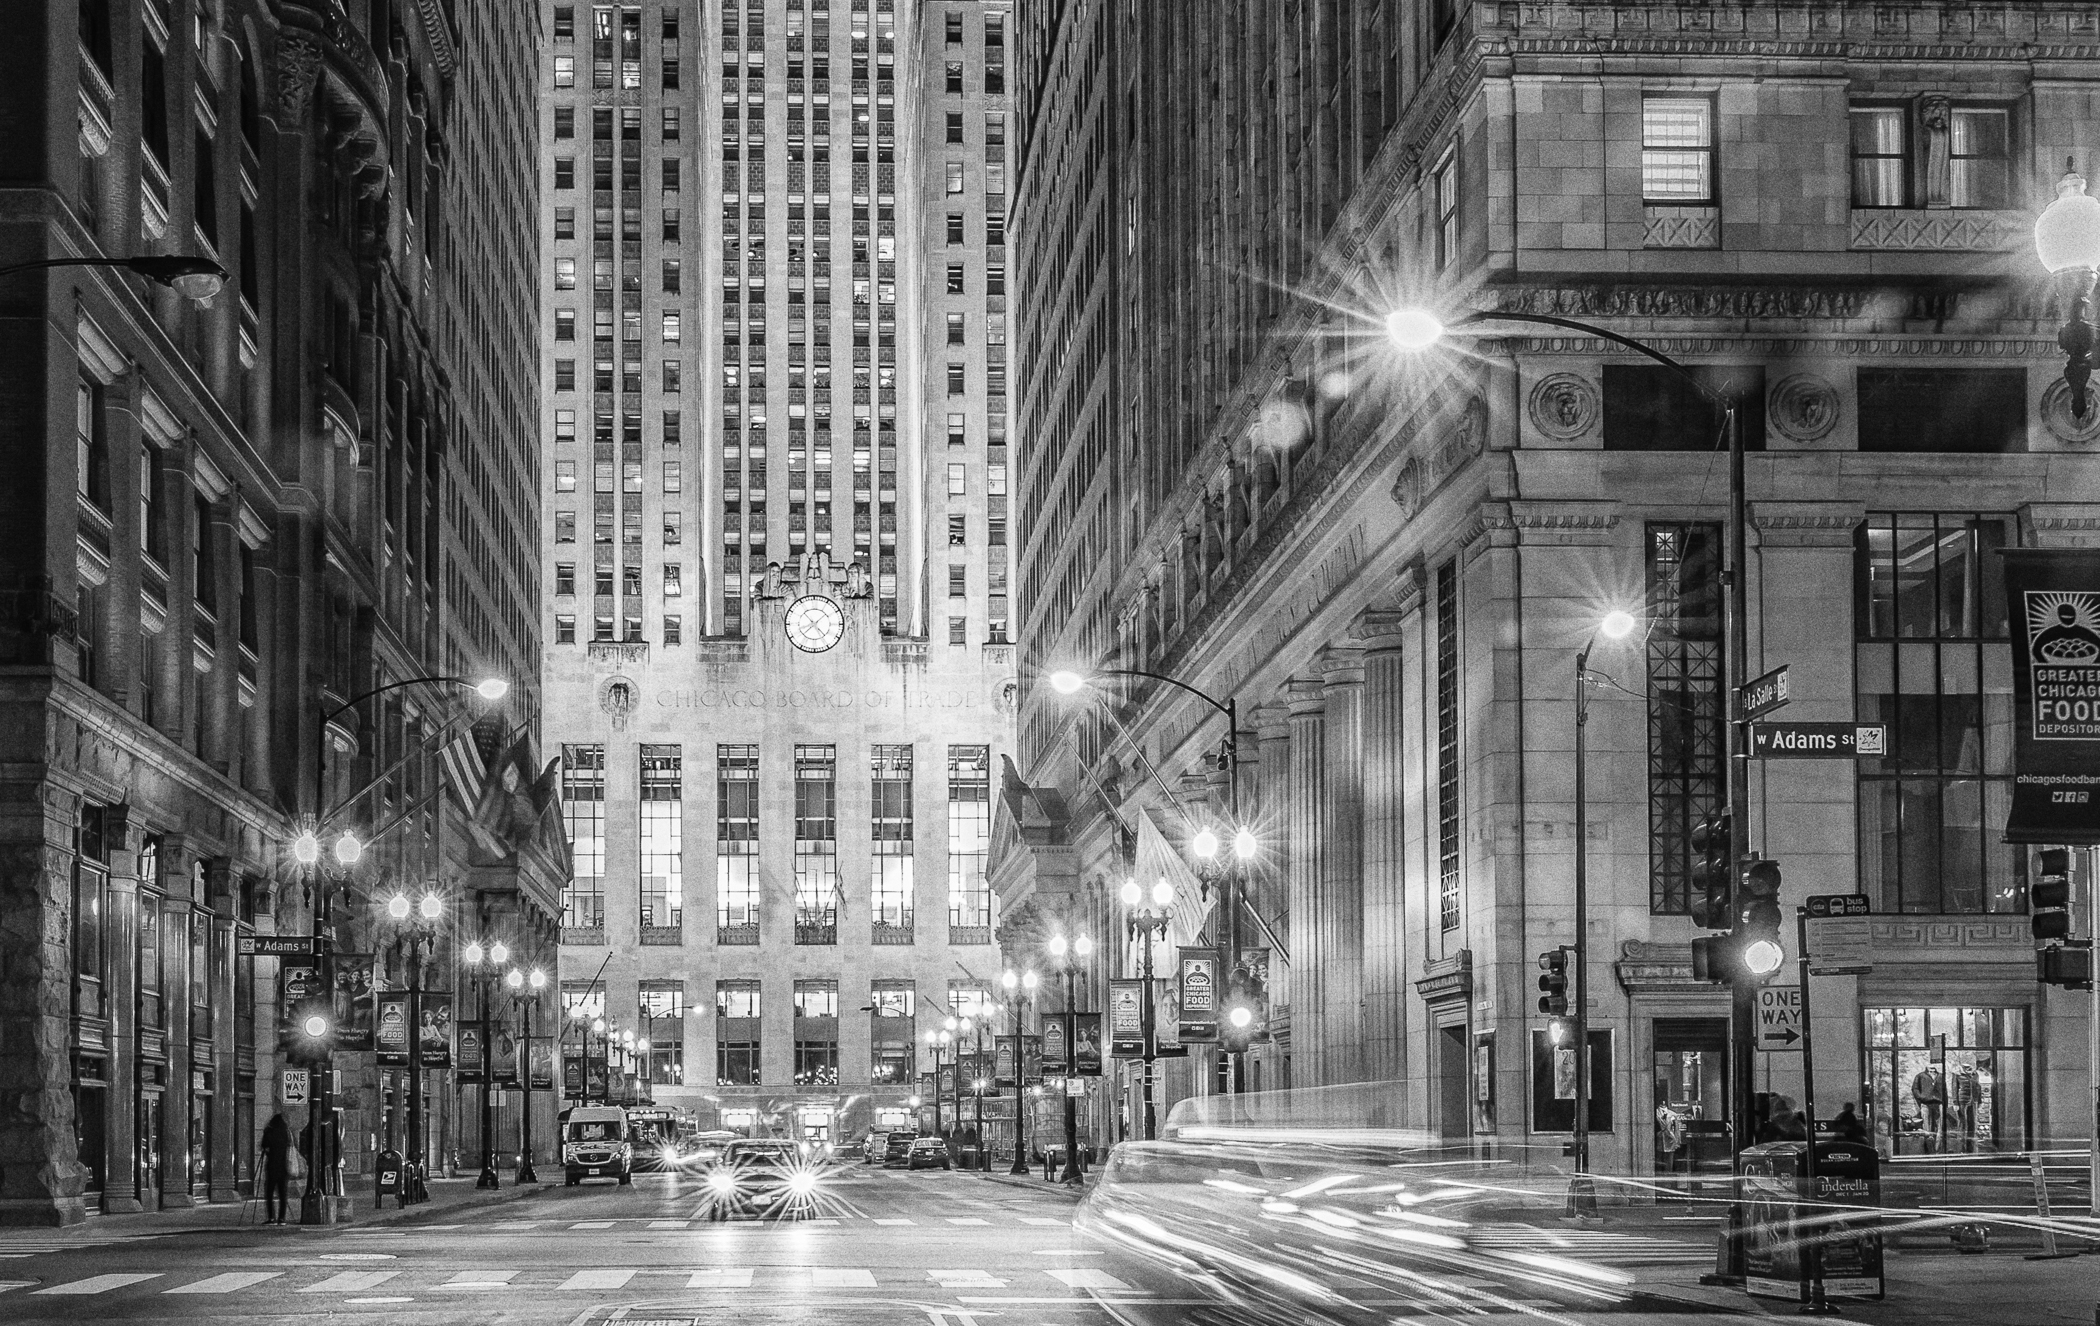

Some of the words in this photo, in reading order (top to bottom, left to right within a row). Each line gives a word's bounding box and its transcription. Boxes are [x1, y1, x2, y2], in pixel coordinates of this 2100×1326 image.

[1747, 692, 1756, 710] La
[1756, 684, 1773, 706] Salle
[2038, 684, 2100, 697] CHICAG
[656, 690, 766, 708] CHICAGO
[776, 690, 853, 708] BOARD
[864, 690, 893, 708] OF
[907, 690, 977, 708] TRADE
[1757, 734, 1767, 745] W
[1772, 730, 1837, 750] Adams
[1842, 734, 1855, 745] St
[1846, 897, 1864, 905] bus
[1846, 905, 1868, 914] stop
[263, 940, 300, 951] Adams
[1762, 991, 1801, 1006] ONE
[1761, 1009, 1801, 1024] WAY
[285, 1073, 306, 1082] ONE
[285, 1083, 306, 1091] WAY
